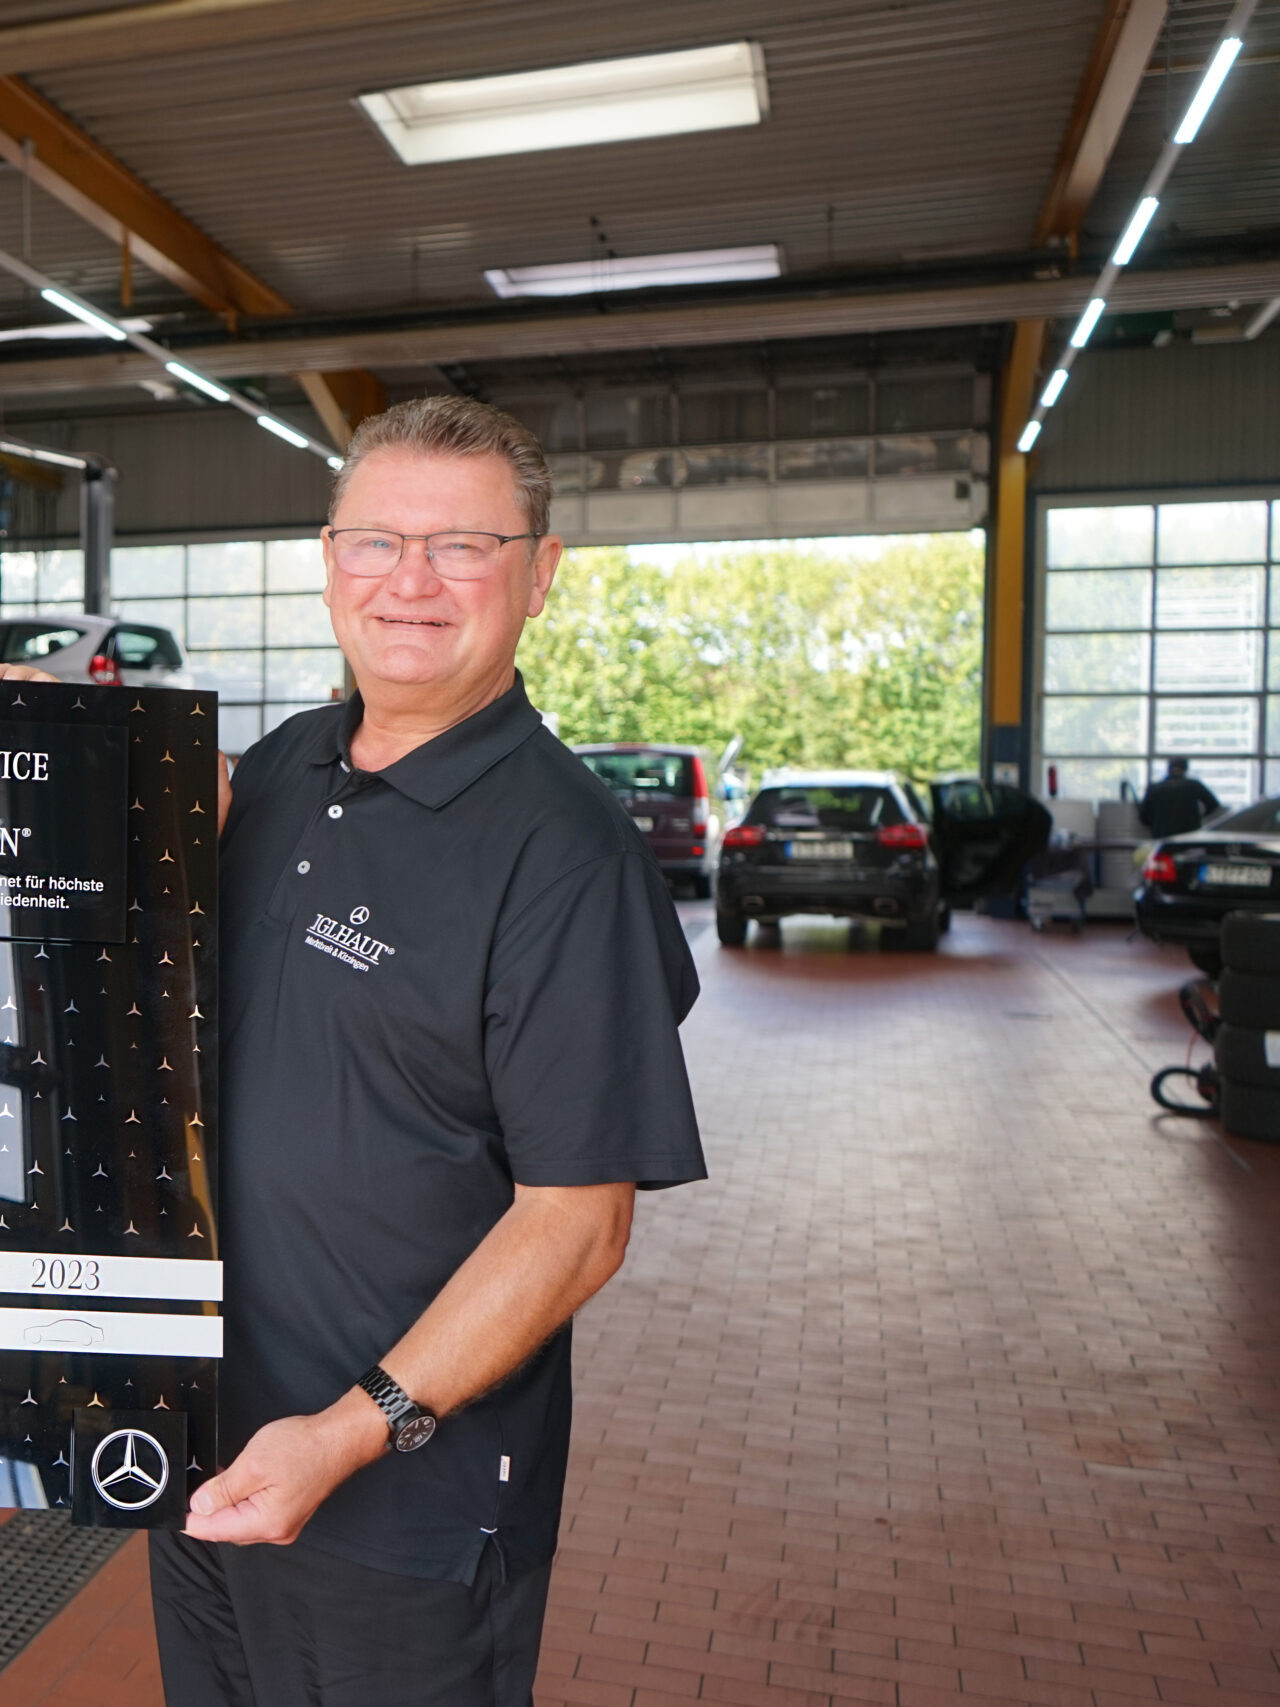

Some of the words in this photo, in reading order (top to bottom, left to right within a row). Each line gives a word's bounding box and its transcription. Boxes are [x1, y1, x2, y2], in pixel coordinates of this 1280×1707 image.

[25, 875, 46, 889] für
[48, 877, 104, 892] höchste
[31, 1258, 101, 1291] 2023
